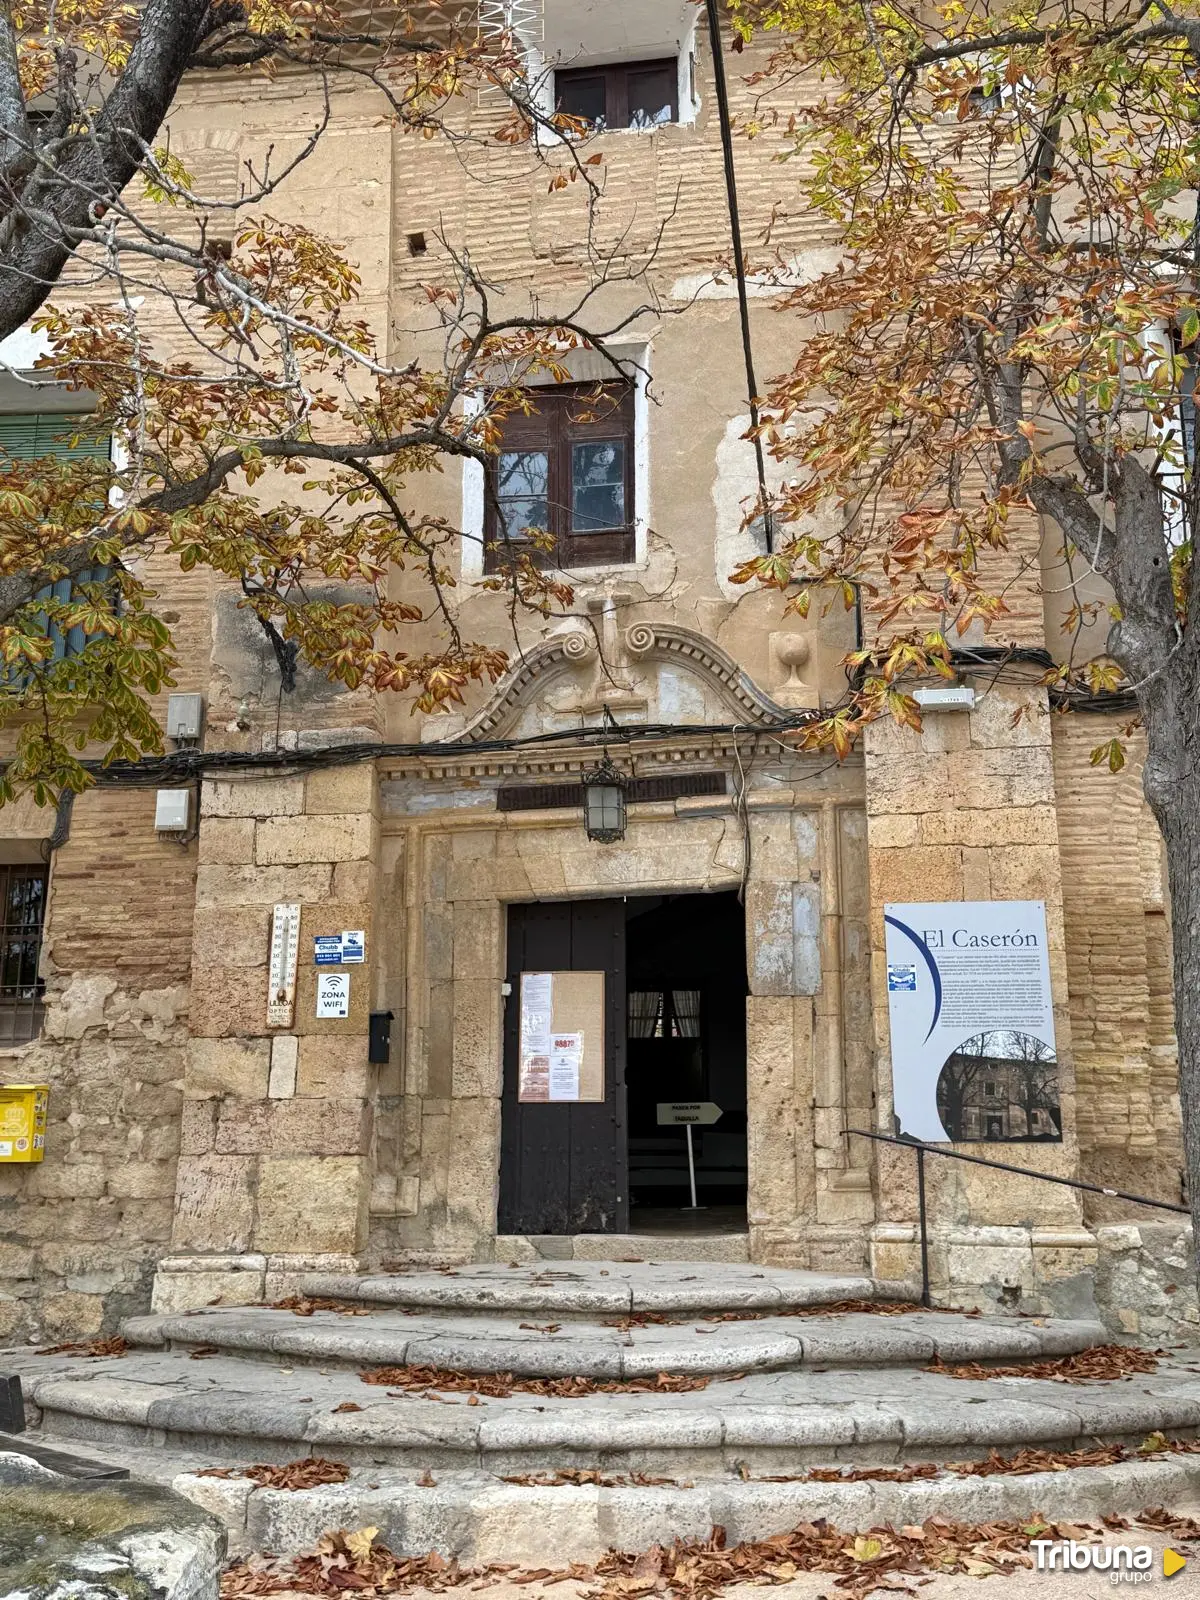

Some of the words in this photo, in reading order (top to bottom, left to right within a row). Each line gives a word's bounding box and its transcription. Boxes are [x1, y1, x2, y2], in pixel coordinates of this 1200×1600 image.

[921, 929, 944, 948] El
[952, 929, 1039, 948] Caserón
[321, 991, 346, 999] ZONA
